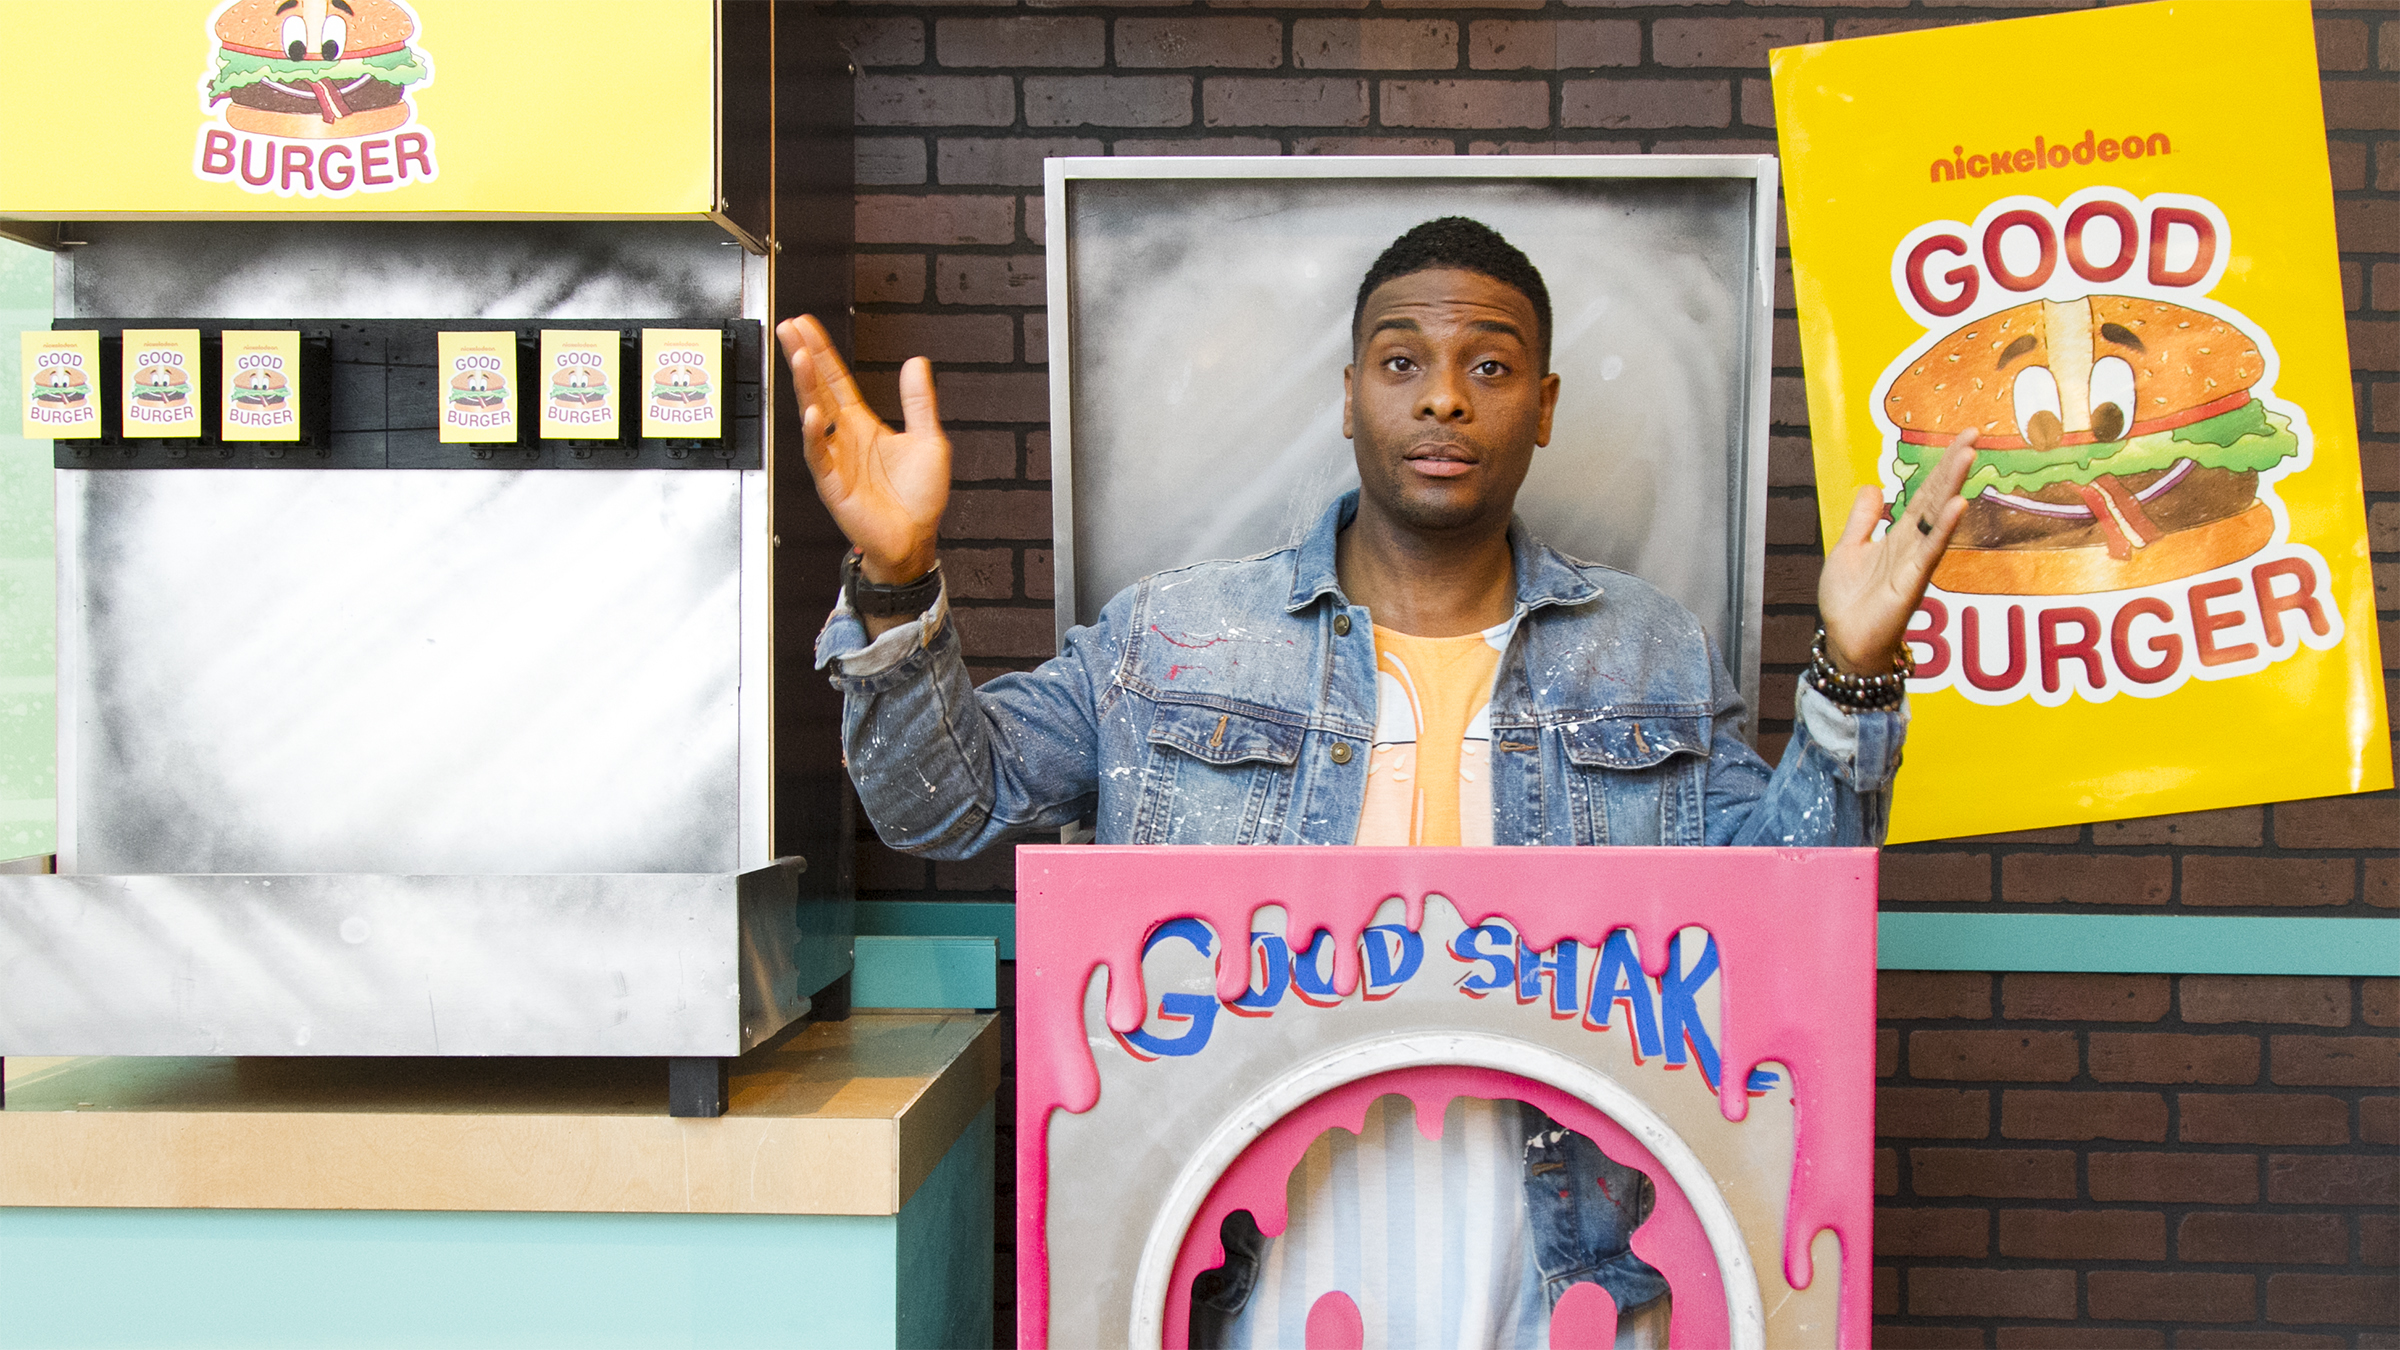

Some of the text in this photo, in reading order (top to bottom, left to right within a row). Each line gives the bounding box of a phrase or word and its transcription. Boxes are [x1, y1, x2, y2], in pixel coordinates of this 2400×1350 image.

[201, 128, 432, 191] BURGER
[1930, 129, 2172, 183] nickelodeon
[1905, 200, 2217, 318] GOOD
[38, 352, 82, 367] GOOD
[139, 352, 183, 366] GOOD
[238, 355, 283, 370] GOOD
[455, 356, 501, 371] GOOD
[557, 353, 602, 367] GOOD
[658, 351, 704, 366] GOOD
[31, 407, 93, 423] BURGER
[130, 405, 194, 423] BURGER
[229, 409, 293, 426] BURGER
[447, 410, 511, 427] BURGER
[548, 406, 612, 424] BURGER
[650, 405, 714, 423] BURGER
[1902, 556, 2331, 694] BURGER
[1107, 915, 1780, 1098] GOOD SHAK
